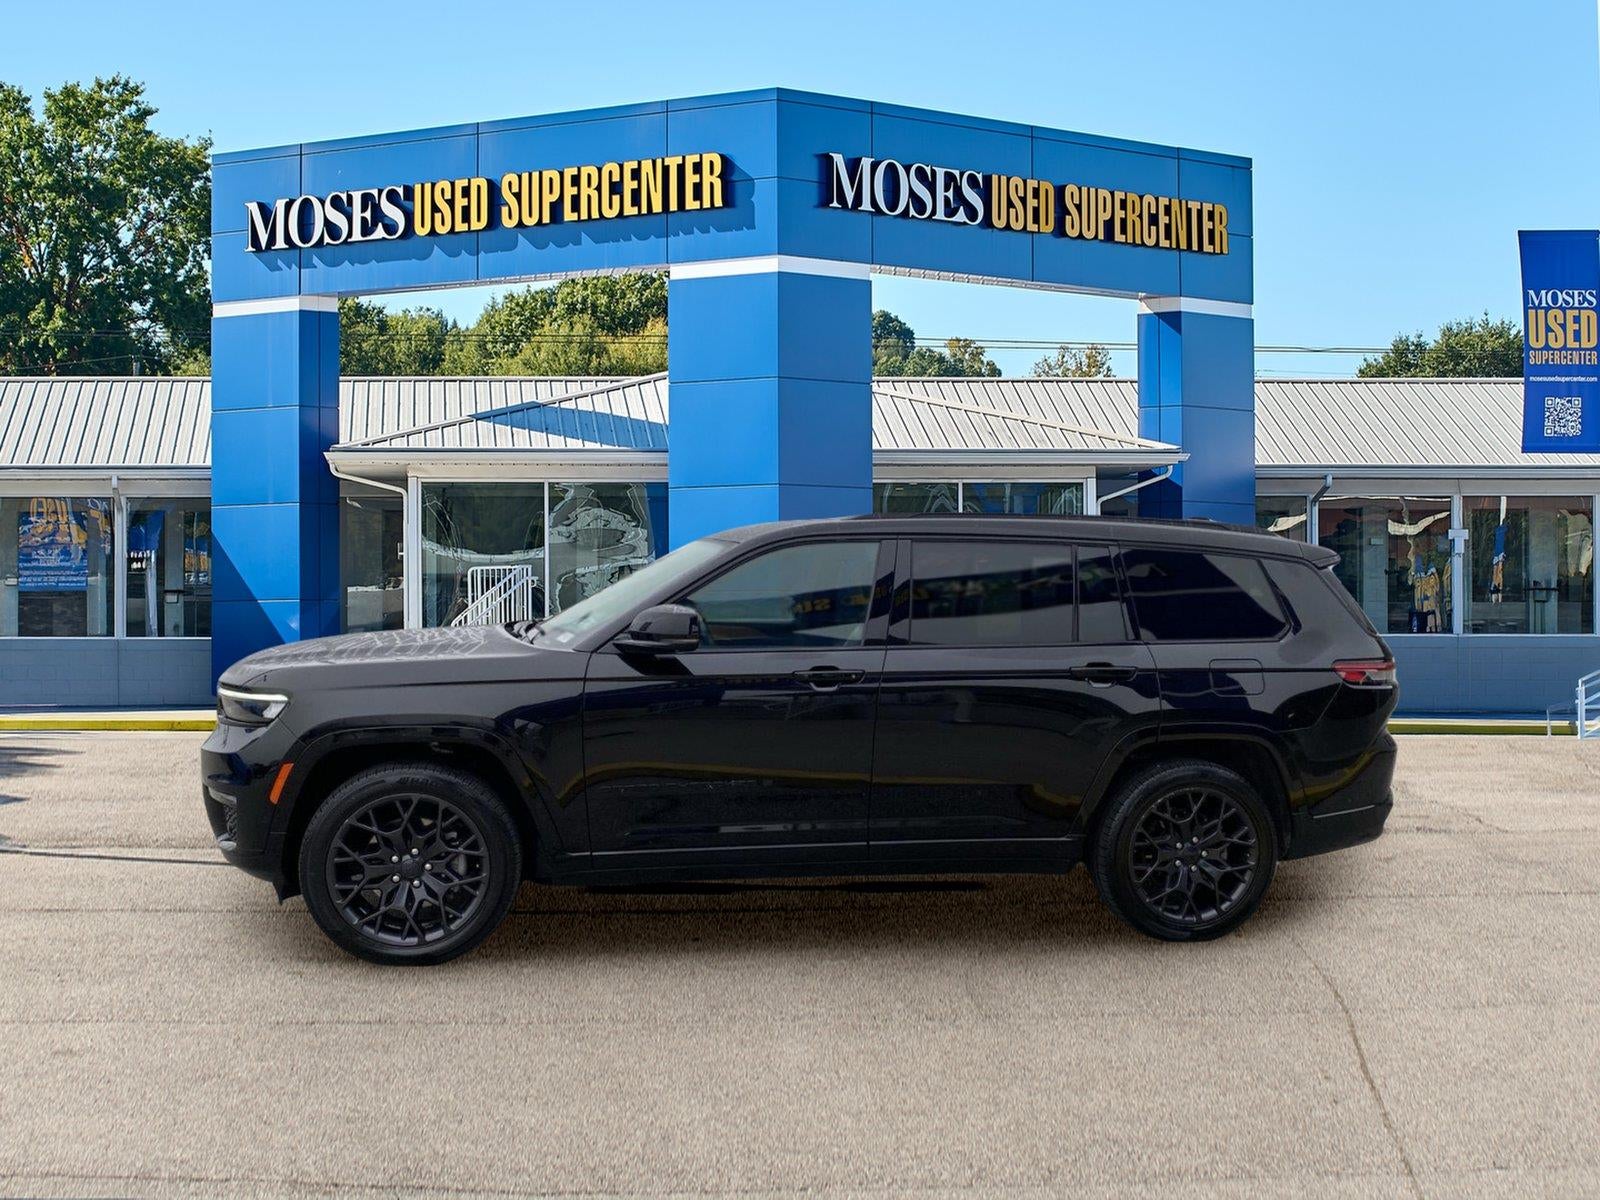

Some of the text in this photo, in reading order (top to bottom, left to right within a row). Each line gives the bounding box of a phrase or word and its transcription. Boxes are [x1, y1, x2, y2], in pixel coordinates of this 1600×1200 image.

[244, 152, 724, 252] MOSES USED SUPERCENTER
[829, 152, 1229, 255] MOSES USED SUPERCENTER
[1527, 289, 1597, 308] MOSES
[1528, 309, 1598, 349] USED
[1529, 350, 1598, 365] SUPERCENTER
[1529, 375, 1598, 383] mosesusedsupercenter.com
